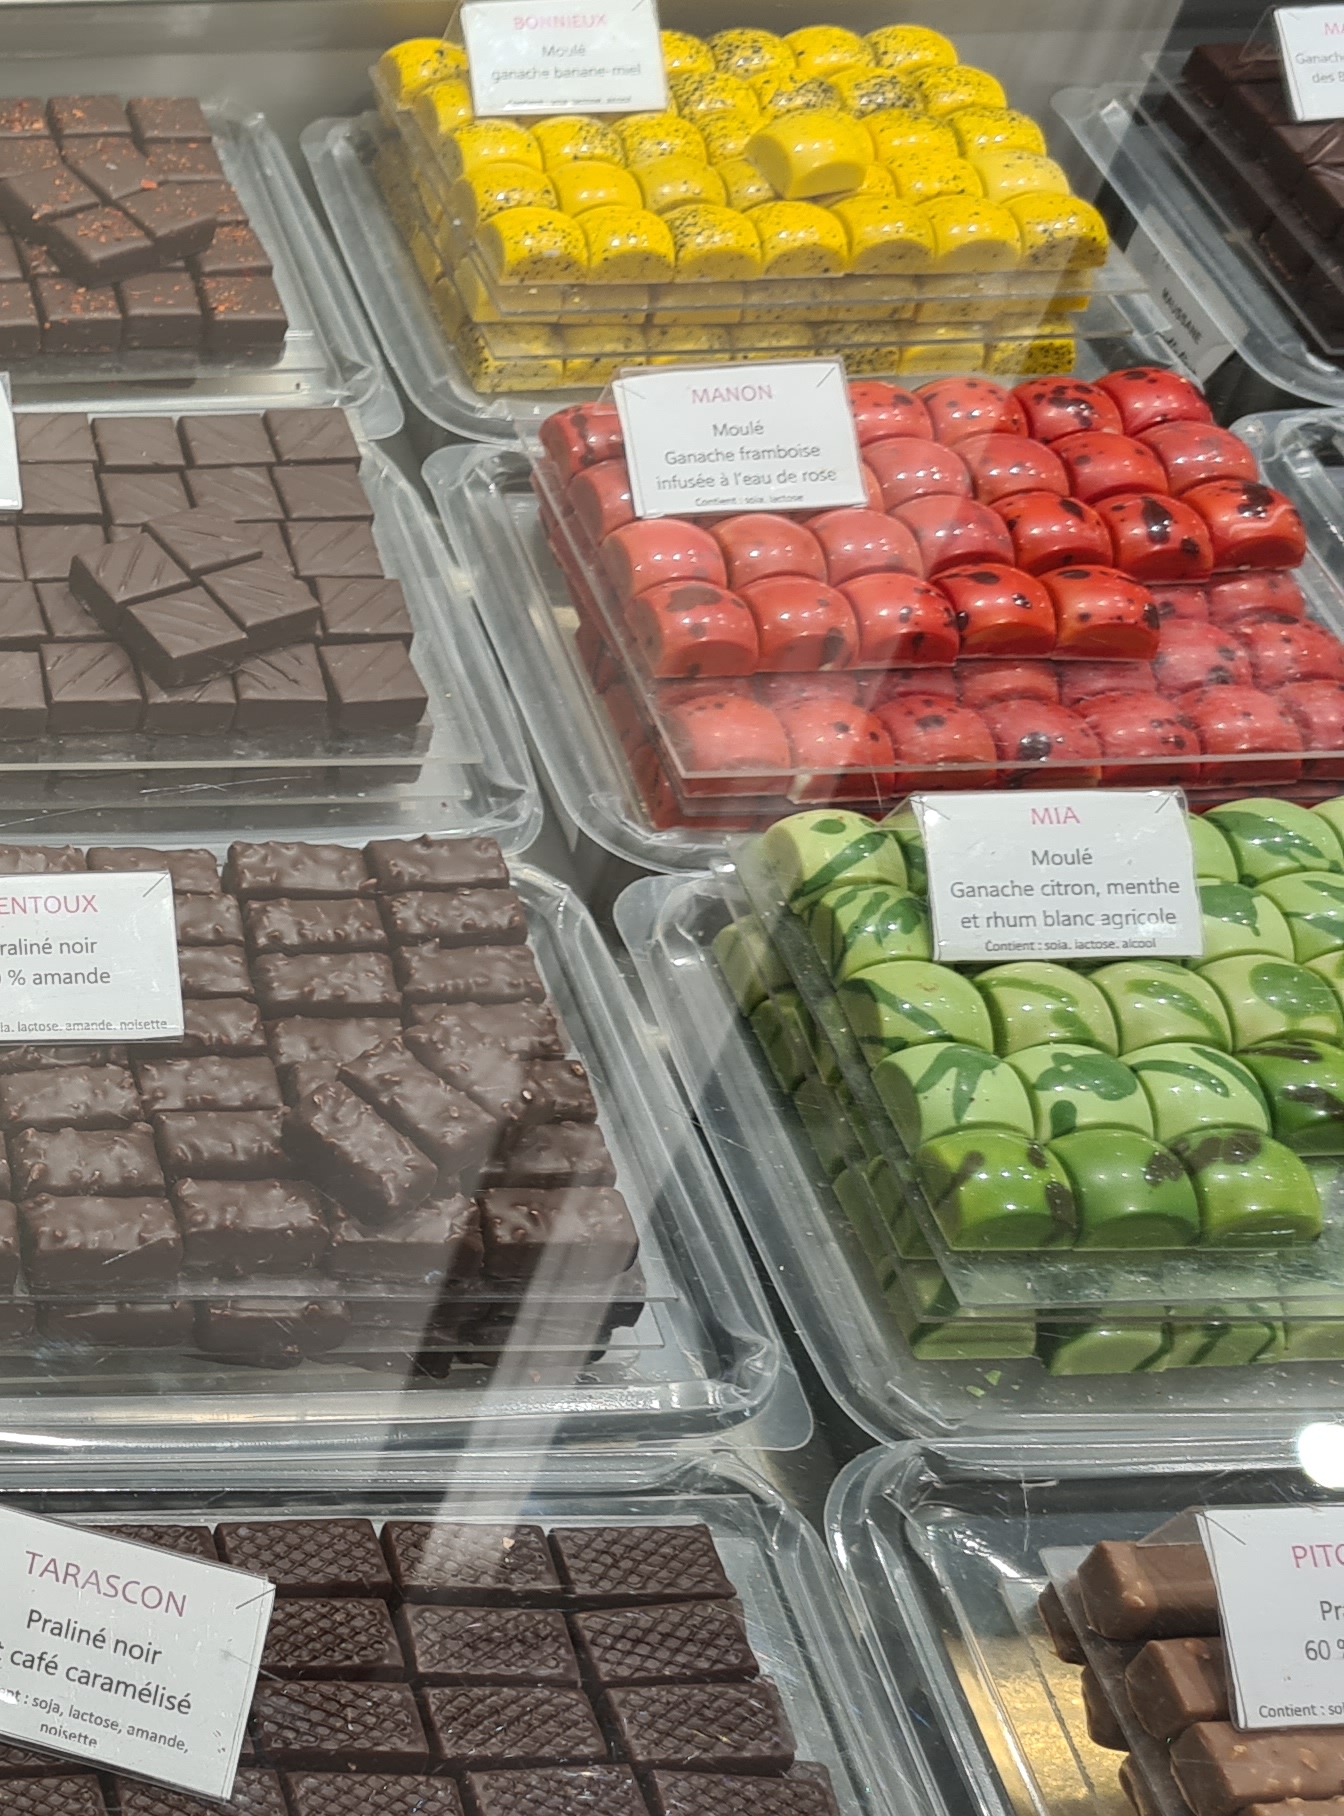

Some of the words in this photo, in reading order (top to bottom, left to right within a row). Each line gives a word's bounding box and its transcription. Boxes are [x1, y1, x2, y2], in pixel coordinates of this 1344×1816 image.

[692, 385, 773, 404] MANON
[713, 420, 763, 437] Moulé
[665, 449, 734, 465] Ganache
[740, 444, 820, 460] framboise
[657, 473, 714, 490] infusée
[720, 472, 729, 486] à
[734, 471, 771, 485] l'eau
[777, 469, 797, 483] de
[802, 470, 837, 482] rose
[1030, 806, 1081, 825] MIA
[1032, 848, 1093, 866] Moulé
[950, 880, 1034, 899] Ganache
[1041, 879, 1101, 898] citron,
[1107, 877, 1180, 895] menthe
[962, 914, 980, 929] et
[986, 911, 1037, 928] rhum
[1043, 910, 1095, 927] blanc
[1100, 908, 1177, 929] agricole
[59, 937, 97, 954] noir
[985, 939, 1035, 952] Contient
[1122, 937, 1156, 949] alcool
[8, 969, 26, 986] %
[33, 967, 111, 985] amande
[120, 1019, 167, 1030] noisette
[25, 1551, 187, 1617] TARASCON
[26, 1609, 106, 1648] Praliné
[113, 1636, 163, 1665] noir
[1305, 1640, 1330, 1660] 60
[10, 1645, 60, 1675] café
[65, 1664, 193, 1714] caramélisé
[1259, 1705, 1317, 1718] Contient
[32, 1696, 63, 1717] soja,
[69, 1705, 122, 1734] lactose,
[127, 1724, 189, 1753] amande,
[40, 1723, 98, 1748] noisette
